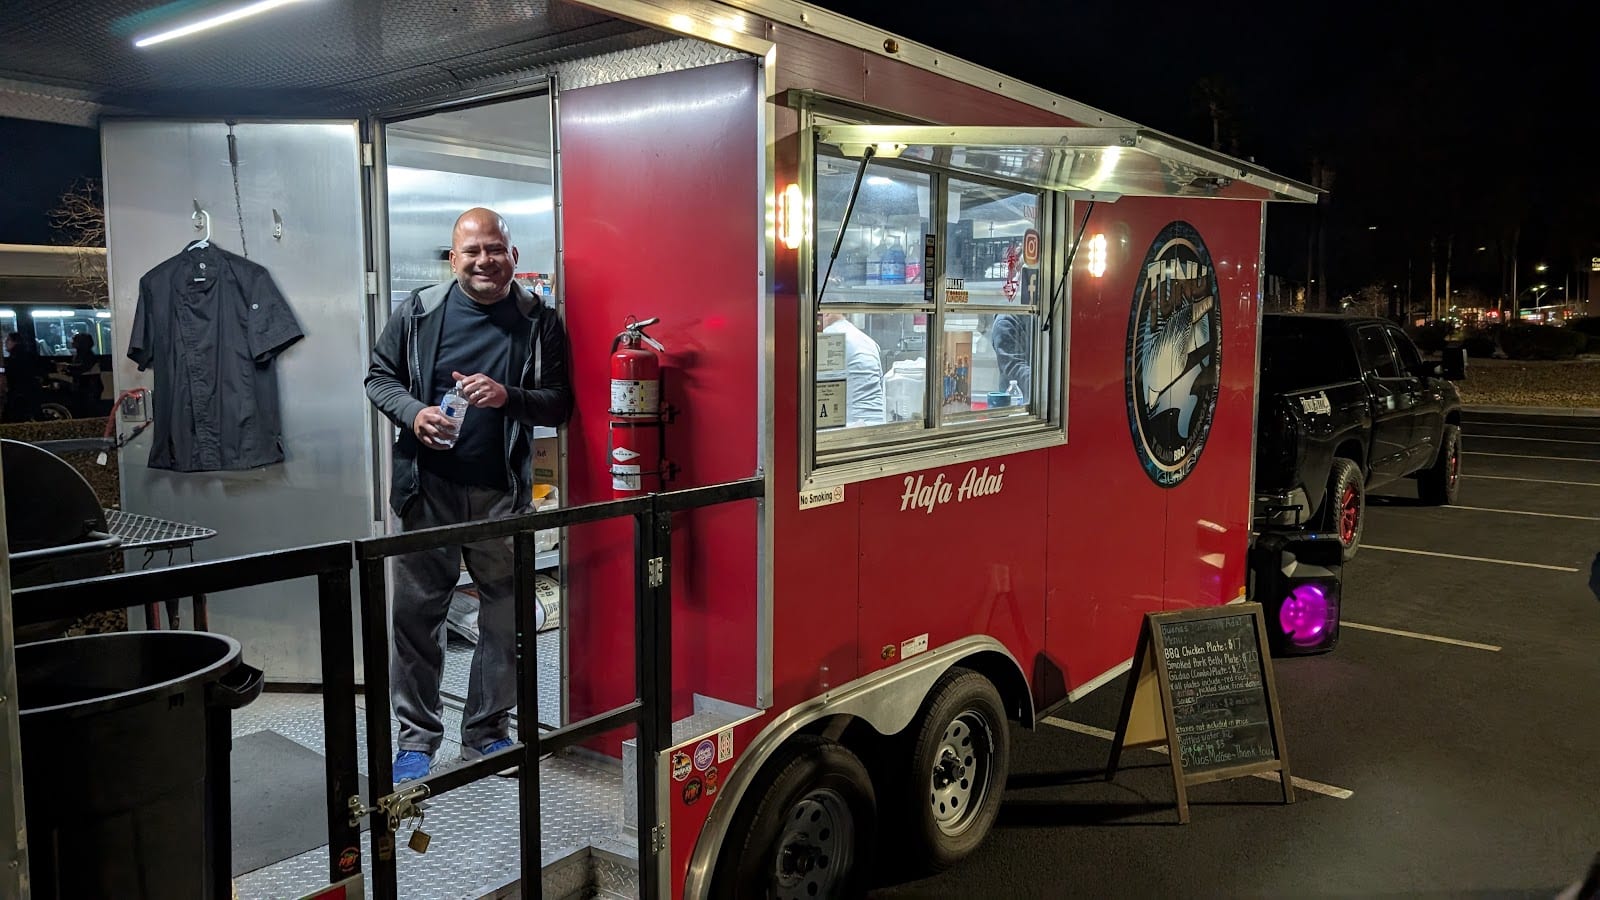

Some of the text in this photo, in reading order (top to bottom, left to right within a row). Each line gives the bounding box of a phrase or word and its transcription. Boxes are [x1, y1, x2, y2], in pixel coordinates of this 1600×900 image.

[819, 403, 829, 419] A
[1173, 445, 1186, 461] BBQ
[900, 463, 1005, 514] Hafa Adai
[800, 491, 833, 505] No Smoking
[1164, 647, 1180, 659] BBQ
[1181, 644, 1205, 657] Chicken
[1206, 641, 1227, 653] Plate:
[1166, 659, 1192, 670] Smoked
[1193, 656, 1207, 668] Pork
[1207, 655, 1223, 666] Belly
[1224, 653, 1241, 664] Plate:
